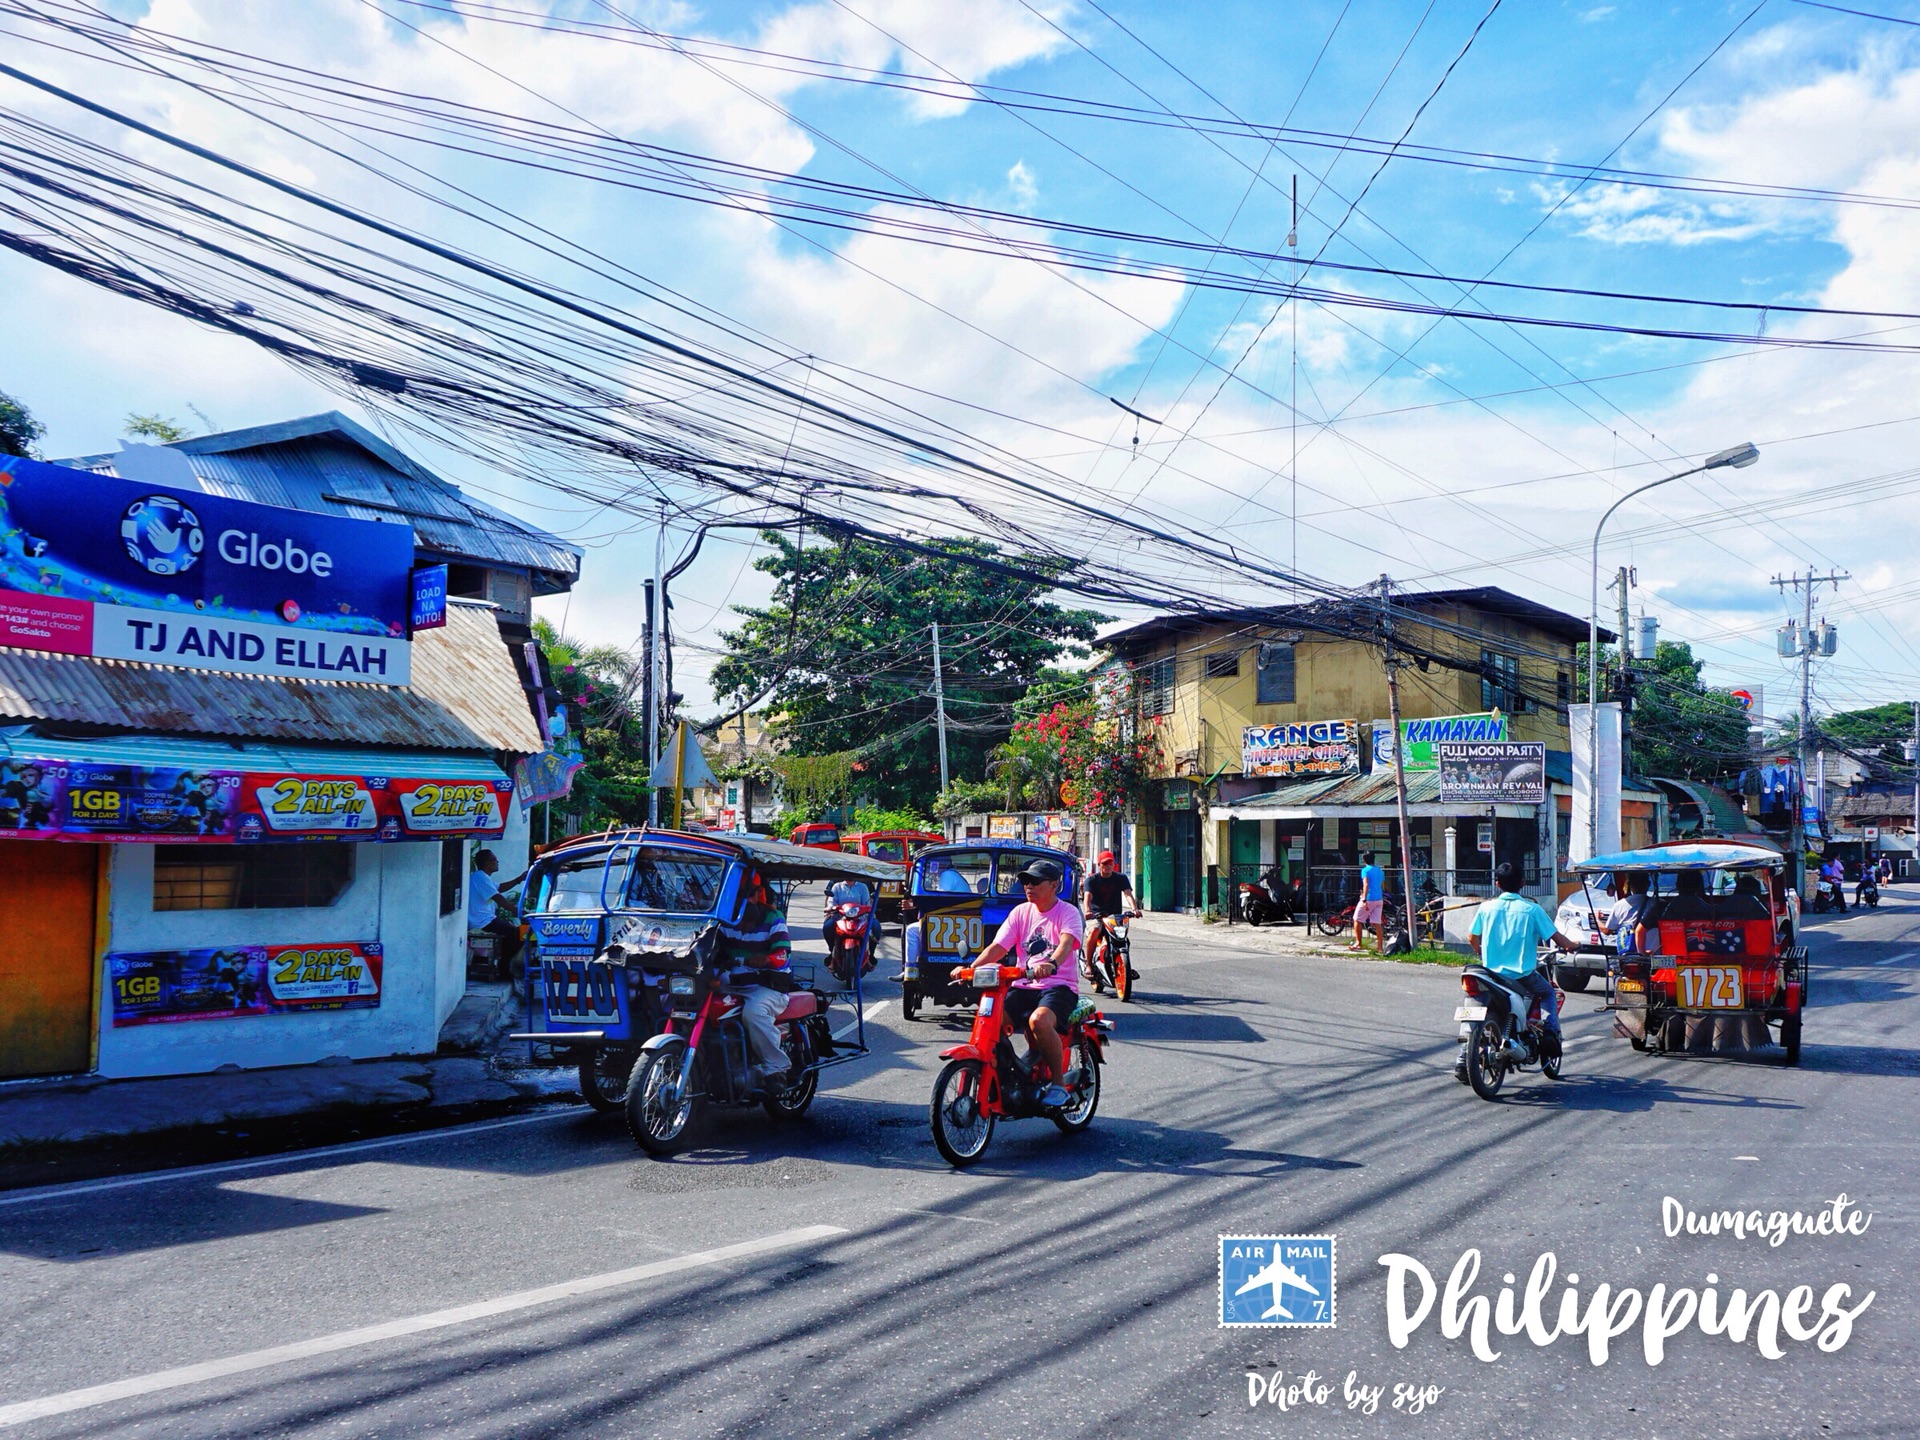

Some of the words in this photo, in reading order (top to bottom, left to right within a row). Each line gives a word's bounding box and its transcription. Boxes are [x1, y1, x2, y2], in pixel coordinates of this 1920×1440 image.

[217, 529, 333, 577] Globe
[416, 586, 441, 600] LOAD
[8, 606, 29, 614] your
[30, 609, 51, 617] own
[421, 600, 435, 612] NA
[30, 618, 47, 627] and
[49, 620, 81, 631] choose
[415, 611, 441, 625] DITO!
[10, 625, 51, 638] GoSakto
[127, 619, 167, 653] TJ
[176, 627, 265, 662] AND
[275, 637, 386, 675] ELLAH
[1248, 722, 1348, 748] RANGE
[1405, 719, 1504, 743] KAMAYAN
[1250, 746, 1311, 762] INTERNET
[1313, 745, 1345, 759] CAFE
[1441, 745, 1467, 756] FULL
[1468, 745, 1504, 756] MOON
[1506, 745, 1542, 756] PARTY
[1255, 765, 1289, 774] OPEN
[1295, 762, 1340, 772] 24HRS
[90, 773, 115, 781] Globe
[306, 782, 357, 799] DAYS
[1503, 782, 1542, 790] REVIVAL
[68, 789, 121, 810] 1GB
[273, 779, 304, 814] 2
[412, 785, 440, 816] 2
[441, 787, 486, 802] DAYS
[72, 810, 90, 818] FOR
[98, 811, 120, 819] DAYS
[301, 799, 366, 814] ALL-IN
[435, 801, 494, 816] ALL-IN
[540, 920, 593, 939] Beverly
[928, 916, 982, 949] 2230
[304, 951, 352, 966] DAYS
[275, 951, 303, 984] 2
[300, 965, 362, 983] ALL-IN
[116, 976, 161, 997] 1GB
[544, 960, 615, 1017] 1270
[1678, 967, 1742, 1007] 1723
[141, 995, 161, 1003] DAYS
